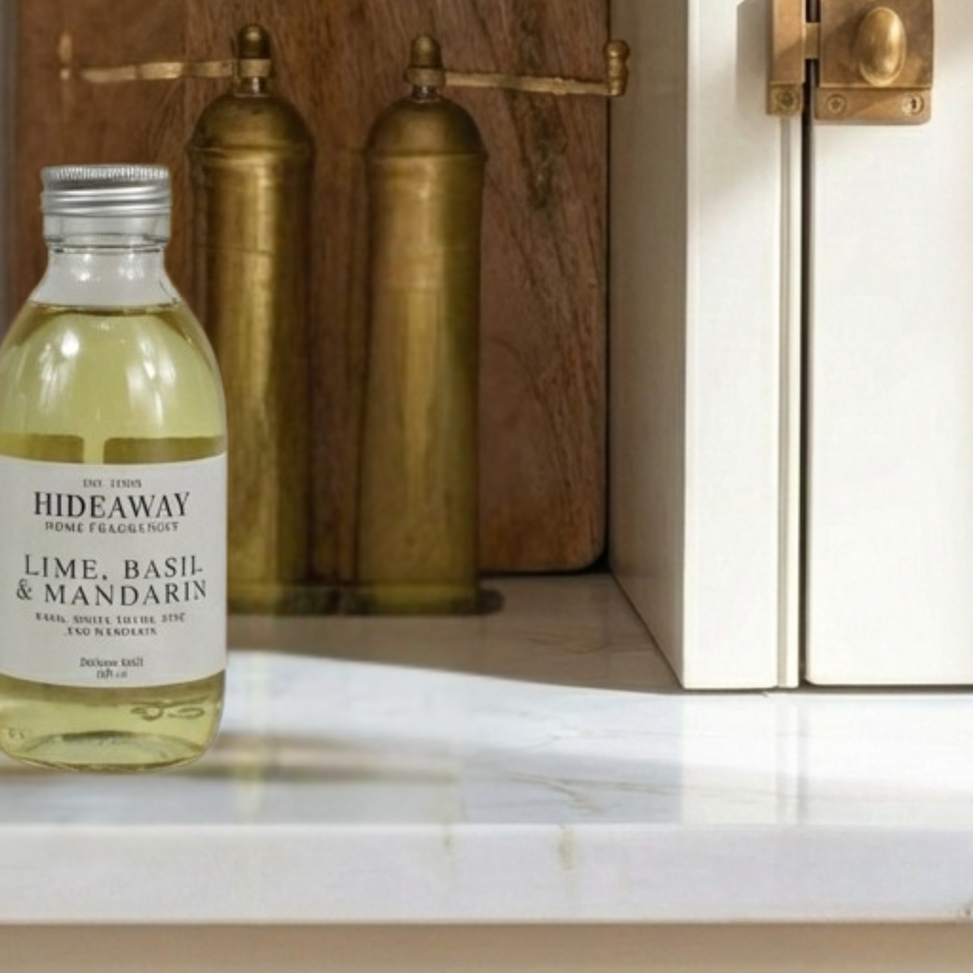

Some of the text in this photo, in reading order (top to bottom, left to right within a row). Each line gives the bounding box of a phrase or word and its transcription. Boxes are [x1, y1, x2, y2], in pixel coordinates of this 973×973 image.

[34, 491, 189, 519] HIDEAWAY
[124, 555, 203, 579] BASIL
[16, 578, 207, 606] & MANDARIN
